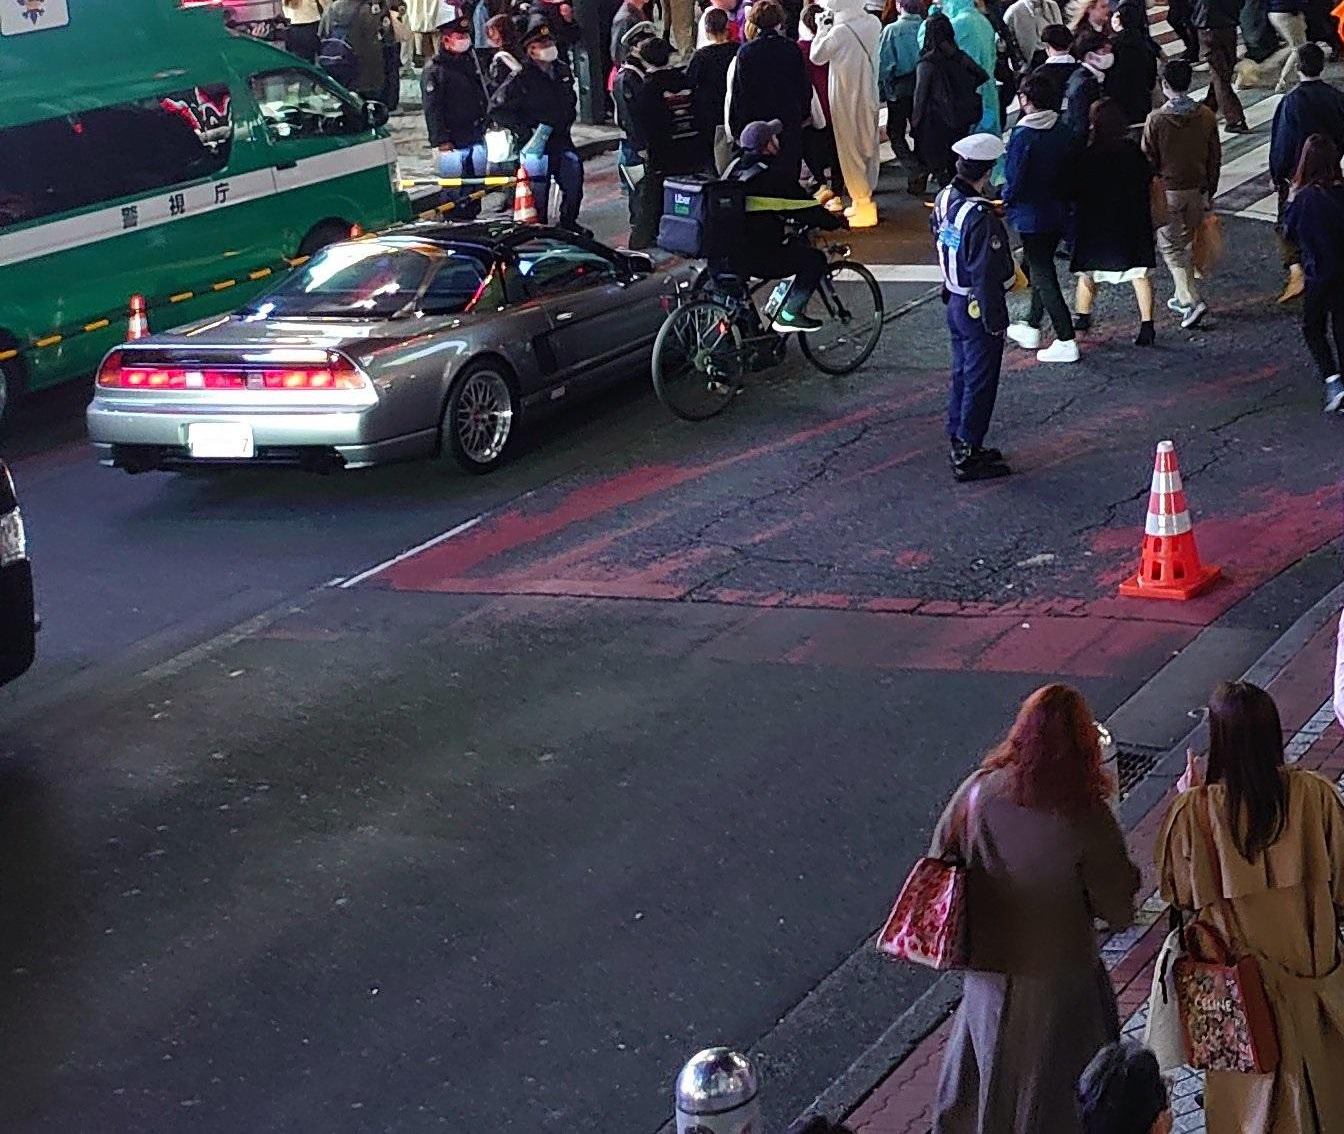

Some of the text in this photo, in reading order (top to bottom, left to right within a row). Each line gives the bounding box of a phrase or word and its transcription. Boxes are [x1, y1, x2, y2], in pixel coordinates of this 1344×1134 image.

[121, 182, 230, 229] 警視庁
[674, 193, 691, 205] Uber
